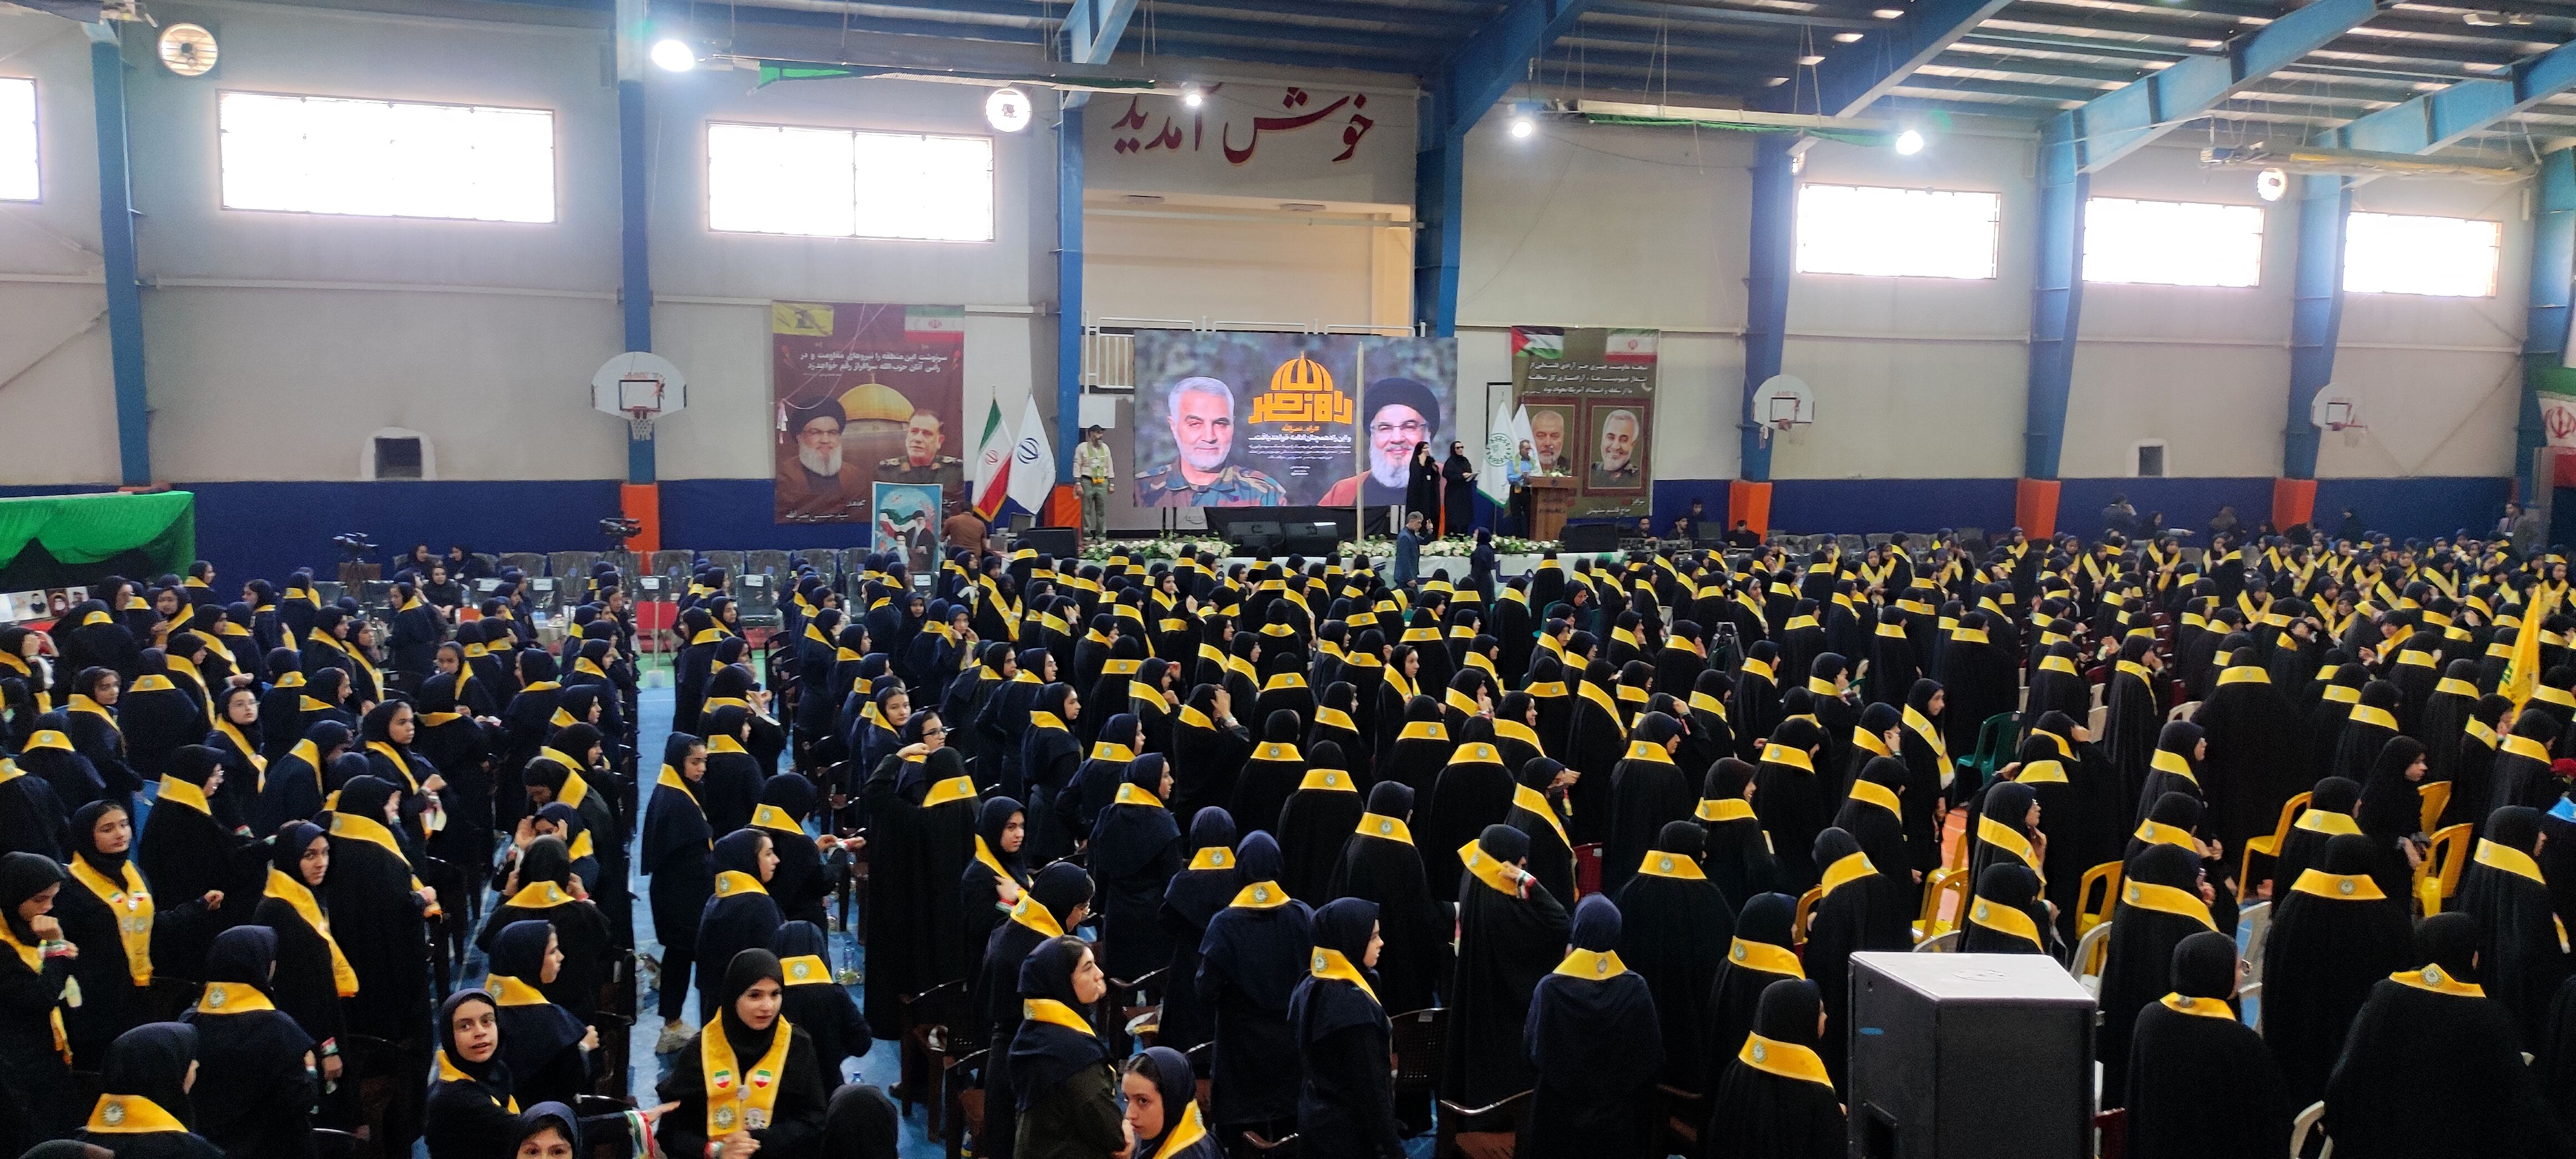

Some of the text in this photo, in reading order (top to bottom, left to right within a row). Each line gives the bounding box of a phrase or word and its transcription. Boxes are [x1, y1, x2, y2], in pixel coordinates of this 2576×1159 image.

[1111, 82, 1374, 164] خوش آمدید
[1248, 390, 1353, 425] راه نصر
